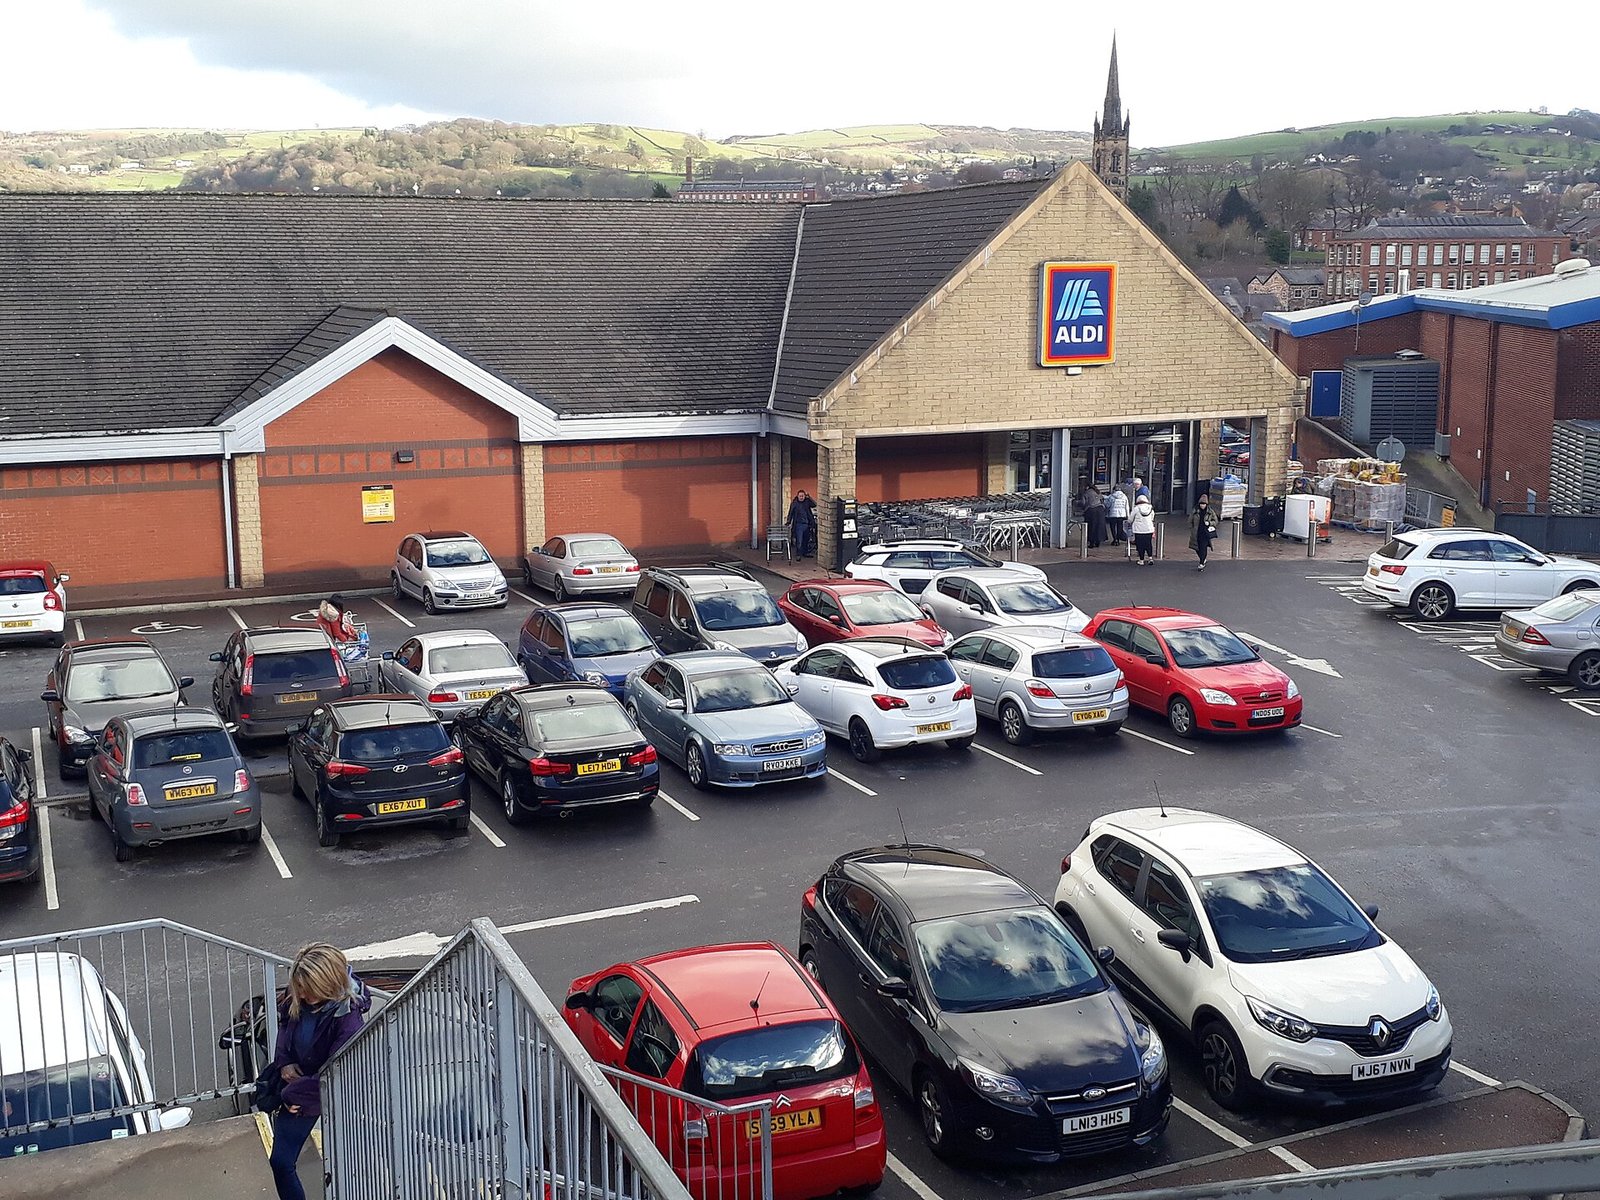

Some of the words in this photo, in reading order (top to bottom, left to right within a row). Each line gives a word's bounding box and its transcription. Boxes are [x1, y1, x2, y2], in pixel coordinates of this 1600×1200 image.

[1054, 325, 1104, 344] ALDI
[469, 691, 487, 700] YE55
[1076, 712, 1092, 721] EY06
[582, 763, 600, 773] LE17
[194, 785, 212, 796] YWH
[382, 801, 405, 812] EX67
[406, 799, 422, 809] XUT
[1357, 1062, 1388, 1078] MJ67
[1389, 1058, 1411, 1073] NVN
[750, 1116, 786, 1135] S59
[789, 1110, 815, 1127] YLA
[1070, 1115, 1098, 1132] LN13
[1100, 1110, 1124, 1127] HHS
